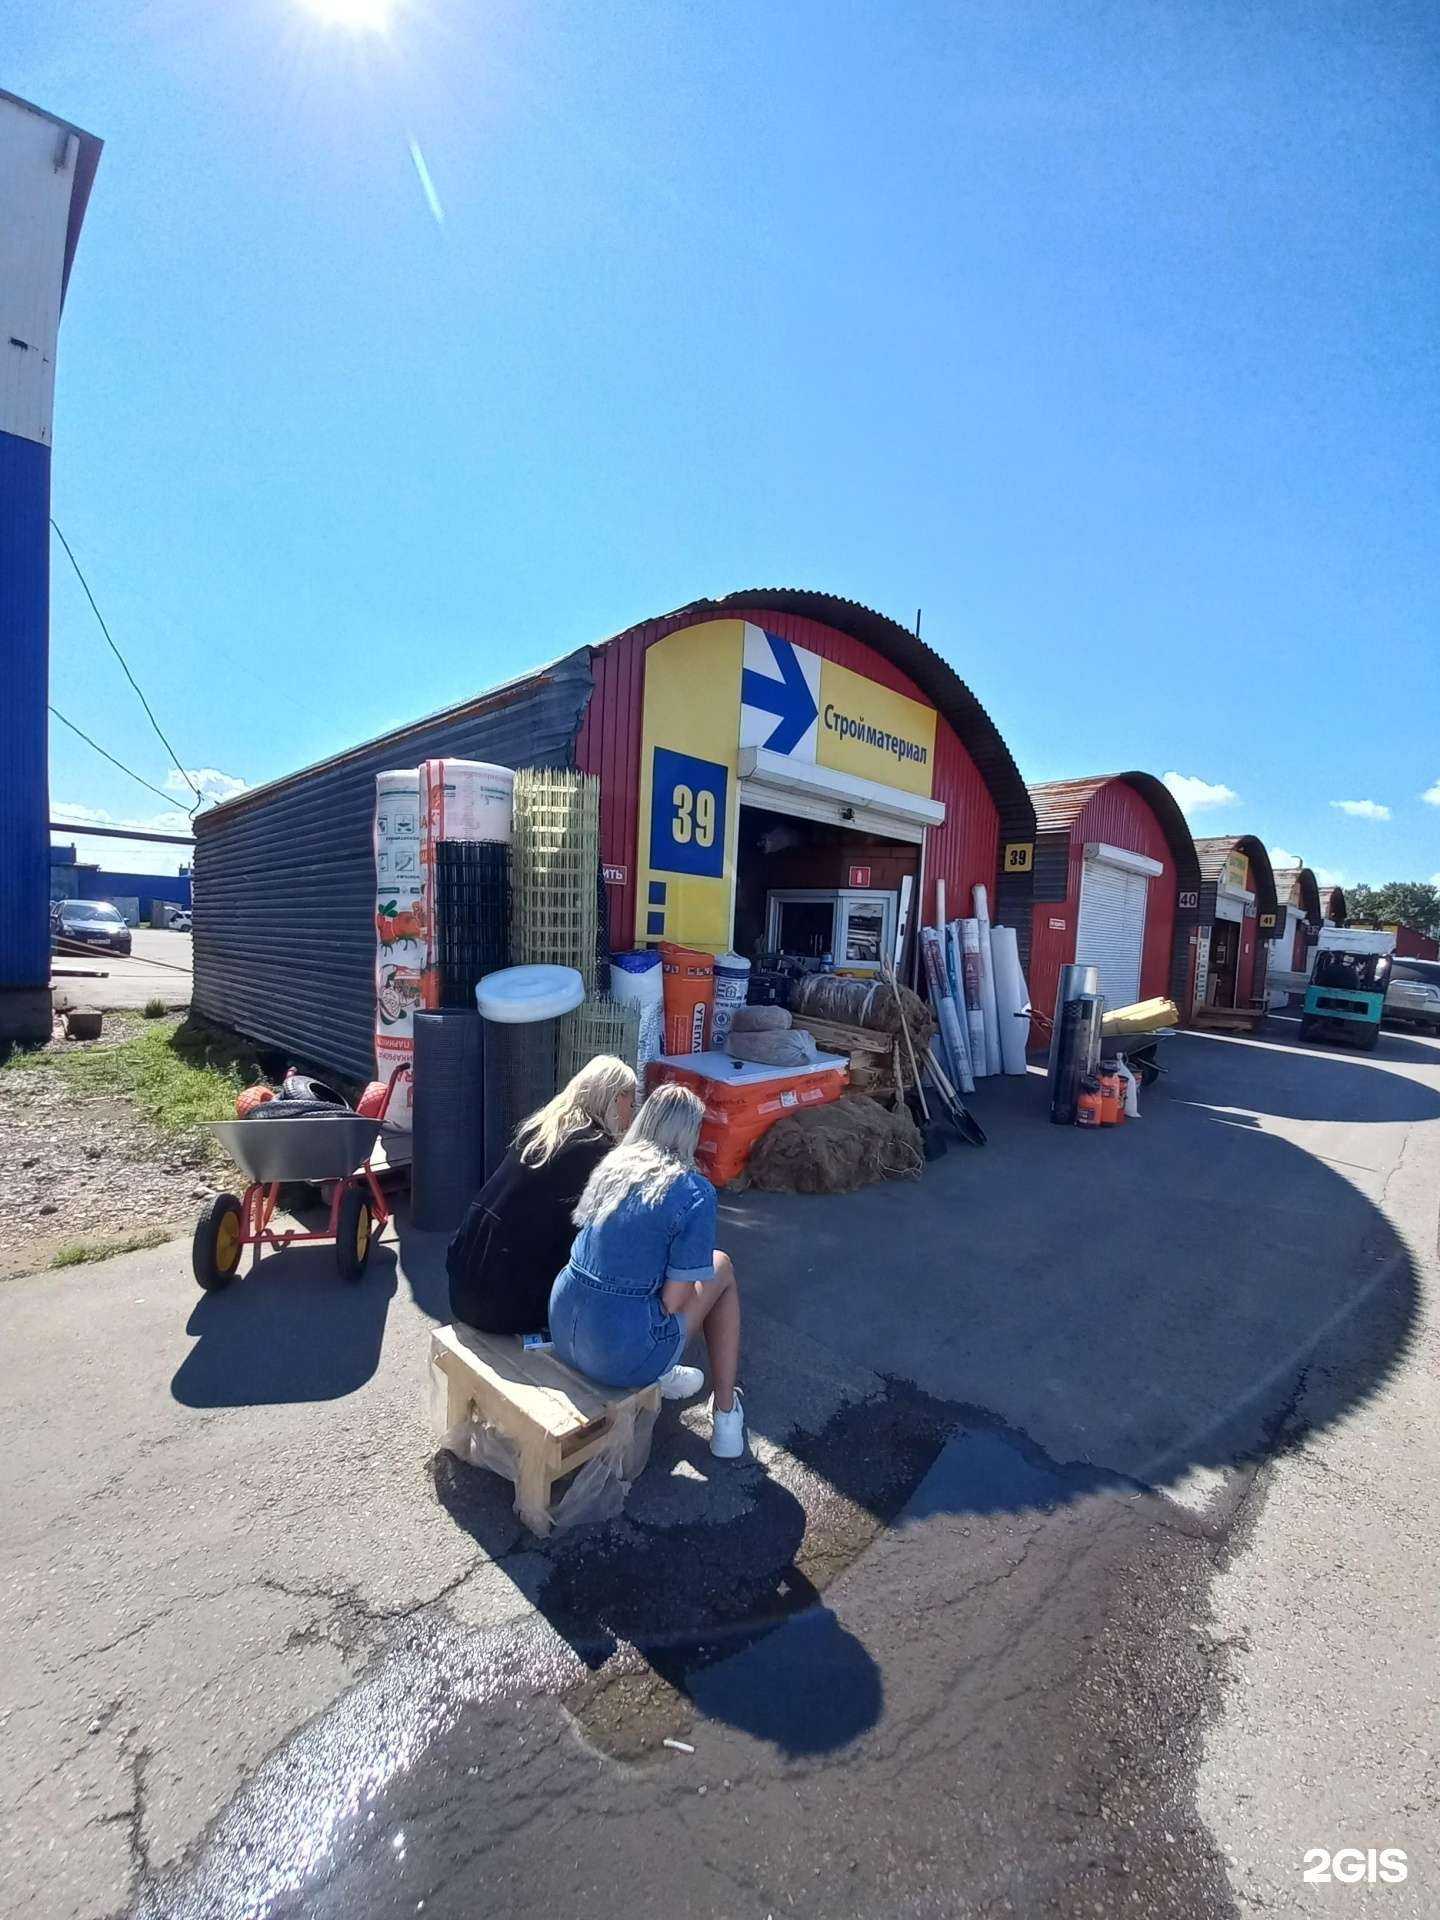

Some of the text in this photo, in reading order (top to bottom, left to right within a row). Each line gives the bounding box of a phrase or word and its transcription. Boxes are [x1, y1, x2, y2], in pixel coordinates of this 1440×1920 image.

[825, 704, 927, 764] Стройматериал
[672, 784, 715, 847] 39
[1009, 850, 1027, 866] 39
[602, 868, 623, 880] ИТЬ
[1180, 894, 1197, 906] 40
[1263, 916, 1273, 925] 41
